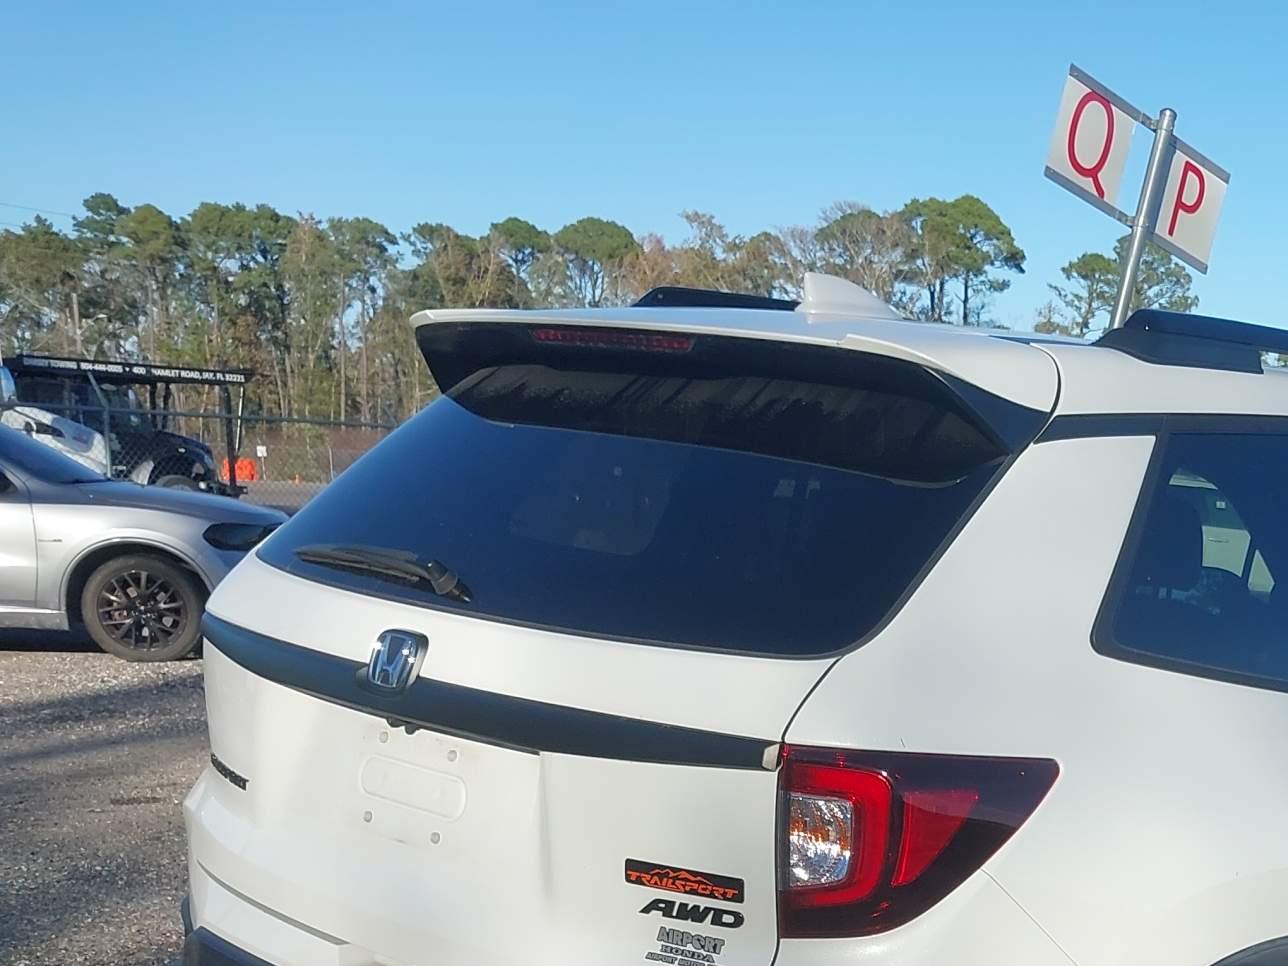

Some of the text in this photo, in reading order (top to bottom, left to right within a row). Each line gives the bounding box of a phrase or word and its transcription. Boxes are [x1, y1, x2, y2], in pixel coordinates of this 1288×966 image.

[1067, 90, 1115, 200] Q
[1167, 160, 1206, 236] P
[626, 870, 739, 899] TRAILSPORT
[638, 898, 745, 929] AWD
[657, 926, 726, 955] AIRPORT
[660, 944, 716, 964] HONDA
[645, 951, 678, 965] AIRPORT
